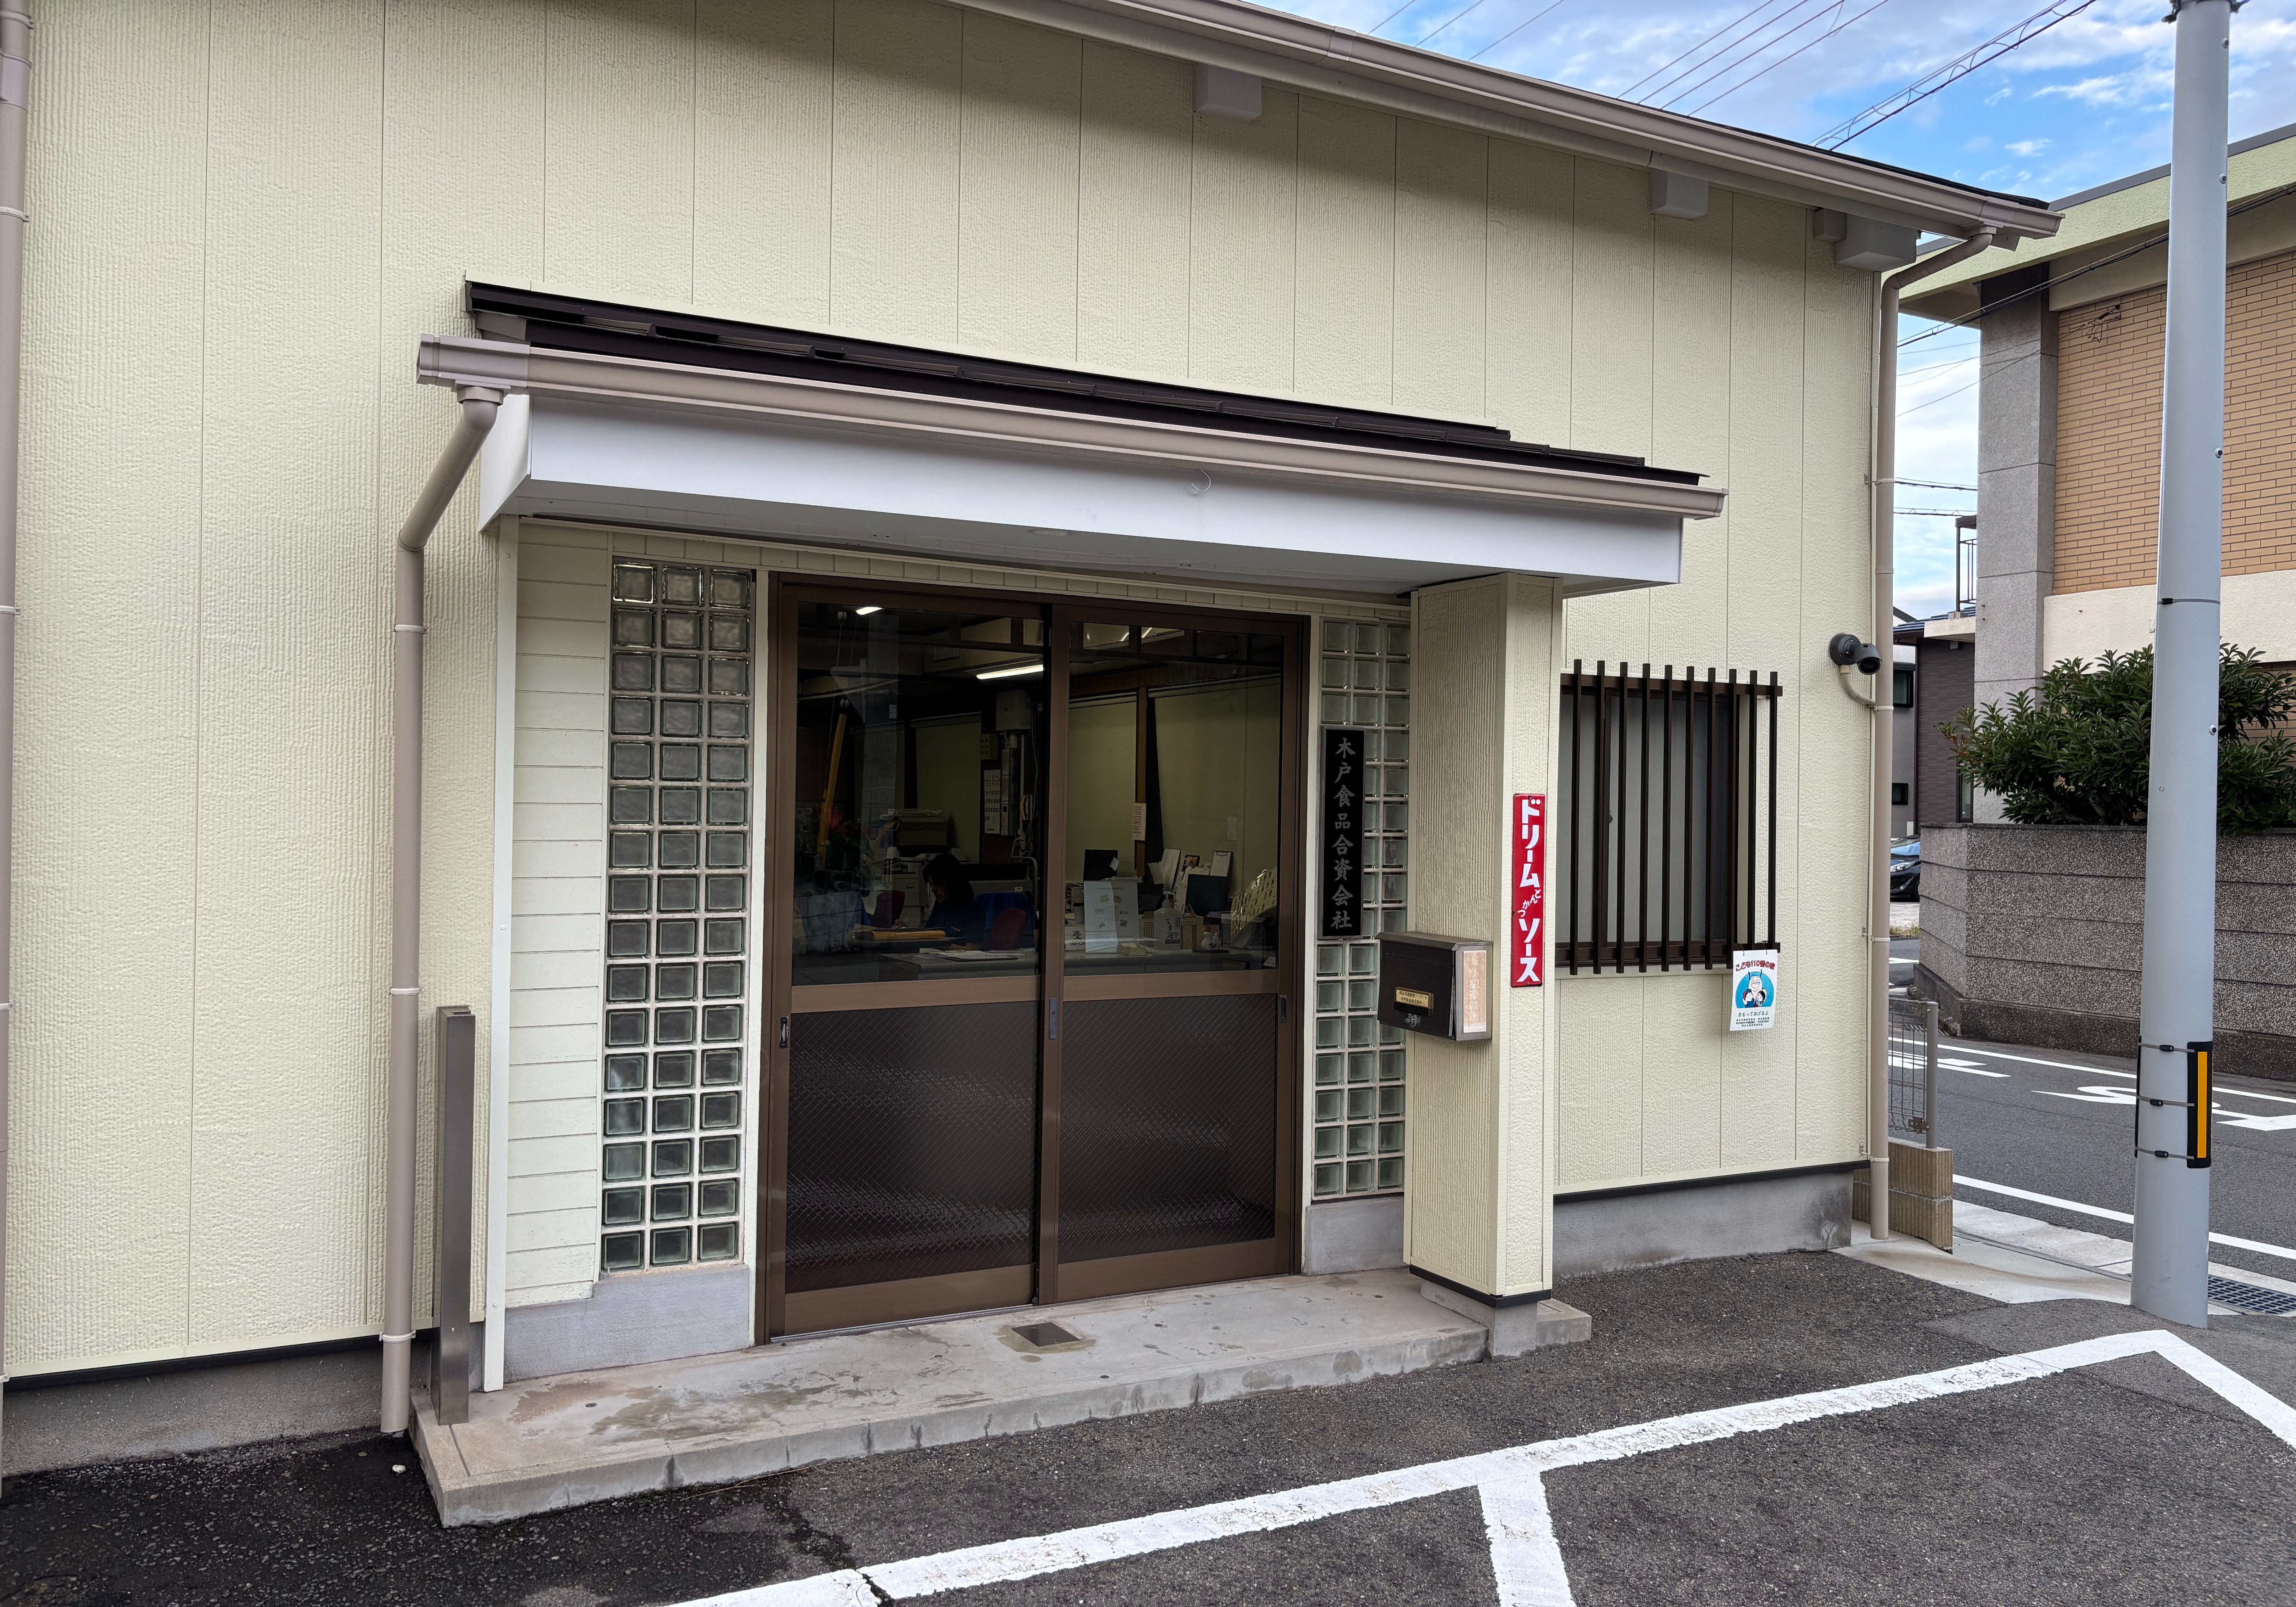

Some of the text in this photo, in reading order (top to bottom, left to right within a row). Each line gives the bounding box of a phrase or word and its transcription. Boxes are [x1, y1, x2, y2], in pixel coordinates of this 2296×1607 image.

[1331, 737, 1356, 930] 木戸食品合資会社
